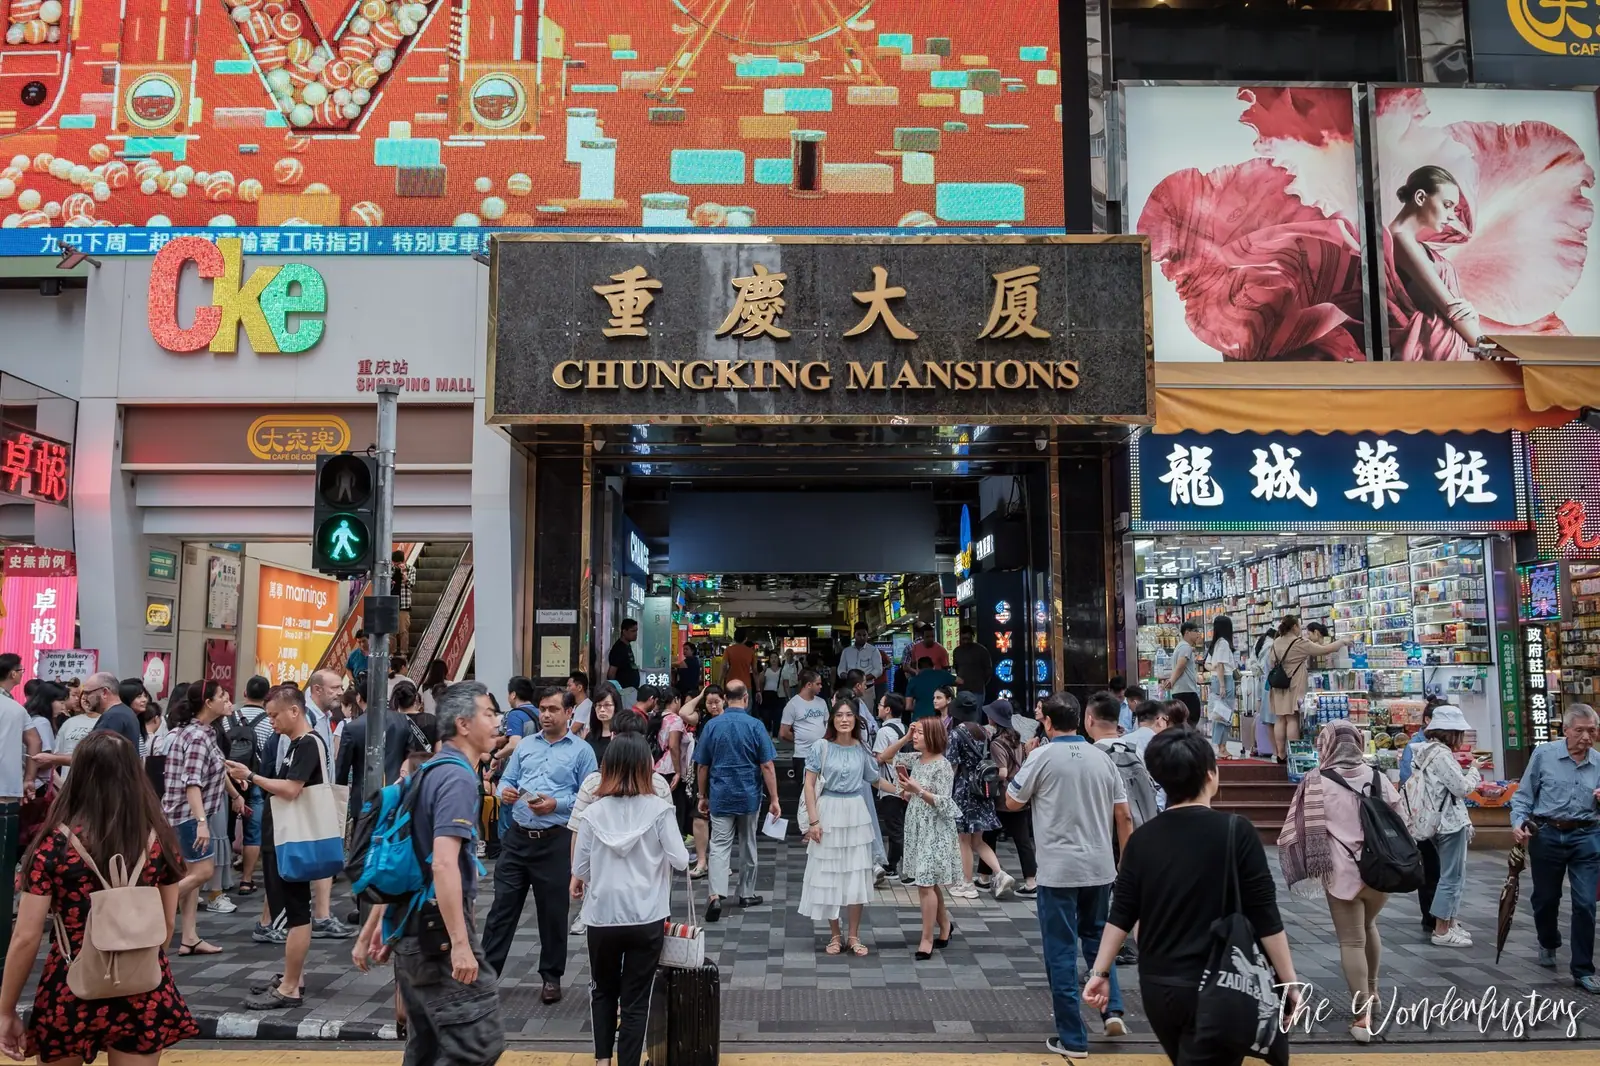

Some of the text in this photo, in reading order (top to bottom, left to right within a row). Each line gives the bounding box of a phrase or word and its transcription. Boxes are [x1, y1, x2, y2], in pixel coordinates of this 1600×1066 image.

[1569, 42, 1600, 56] CAF
[148, 236, 327, 354] Cke
[357, 359, 408, 376] 重庆站
[551, 360, 1080, 391] CHUNGKING MANSIONS
[435, 378, 474, 392] MALL
[1159, 441, 1498, 510] 龍城藥粧
[8, 554, 66, 569] 史無前例
[285, 584, 327, 609] mannings
[1145, 583, 1178, 599] 正貨
[1527, 628, 1545, 688] 政府註冊
